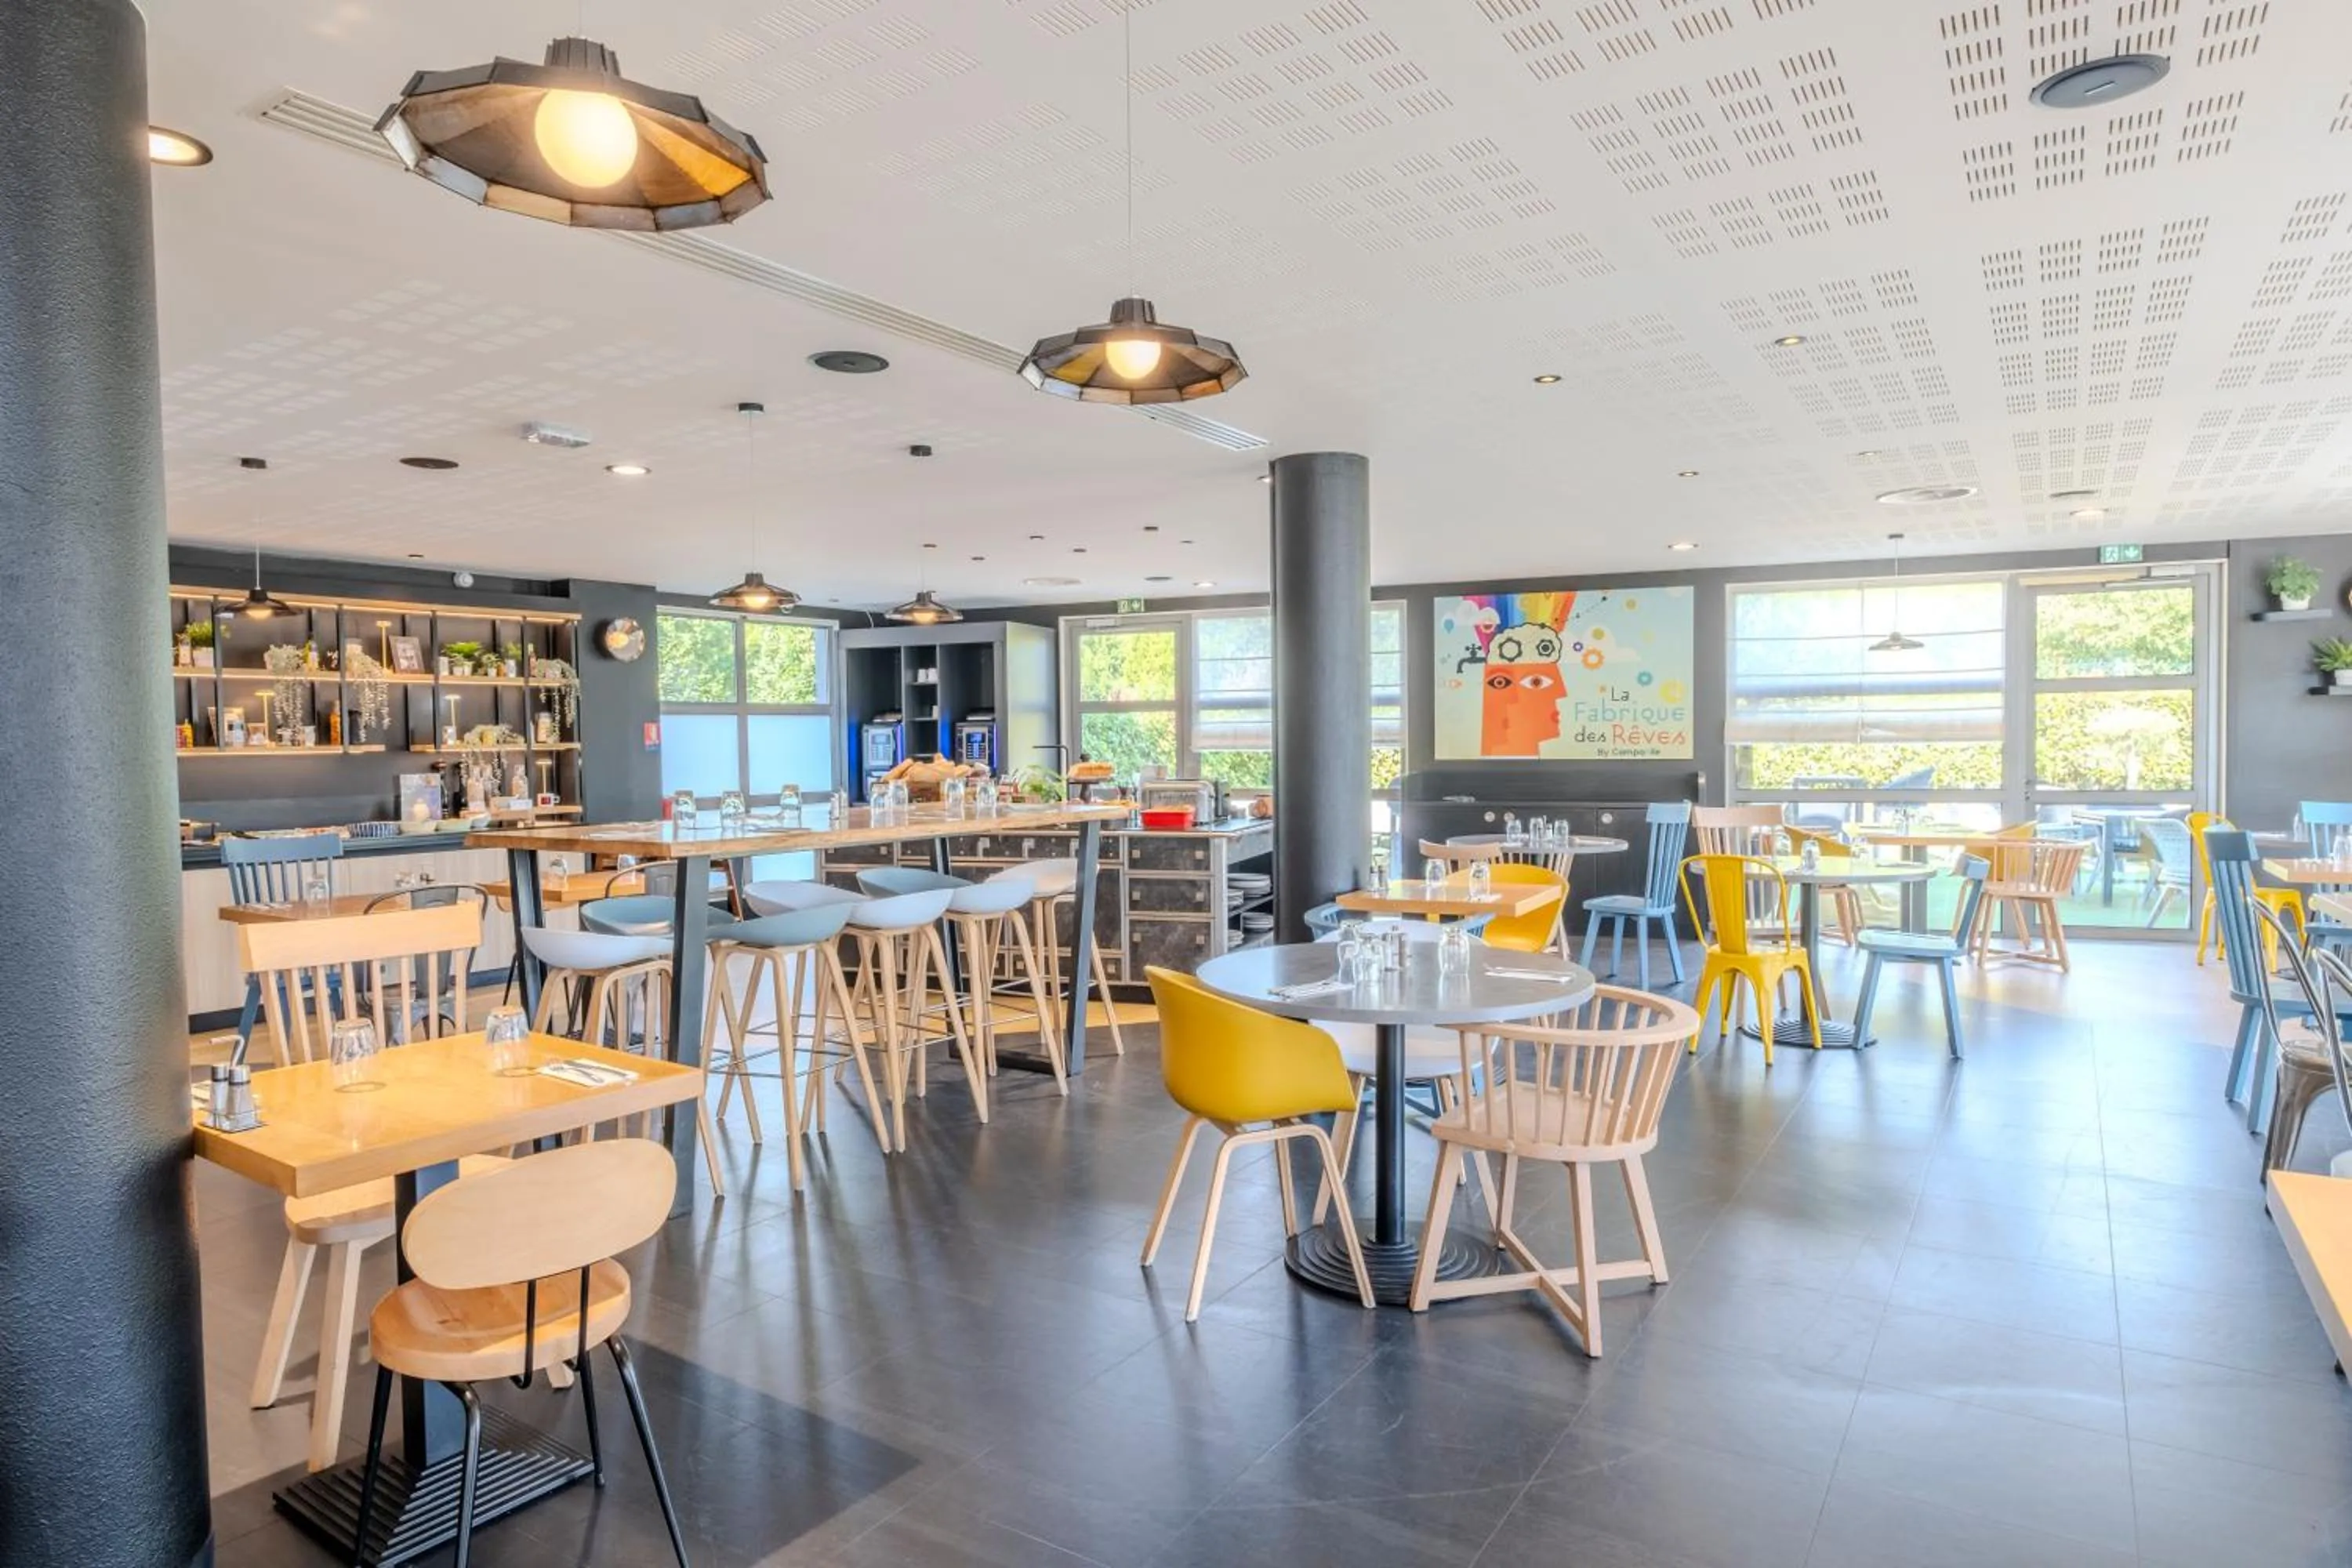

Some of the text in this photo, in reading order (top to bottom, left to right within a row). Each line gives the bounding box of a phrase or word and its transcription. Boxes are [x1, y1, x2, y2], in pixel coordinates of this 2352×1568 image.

[1611, 686, 1629, 701] La
[1575, 697, 1685, 725] Fabrique
[1574, 724, 1686, 744] des Rêves
